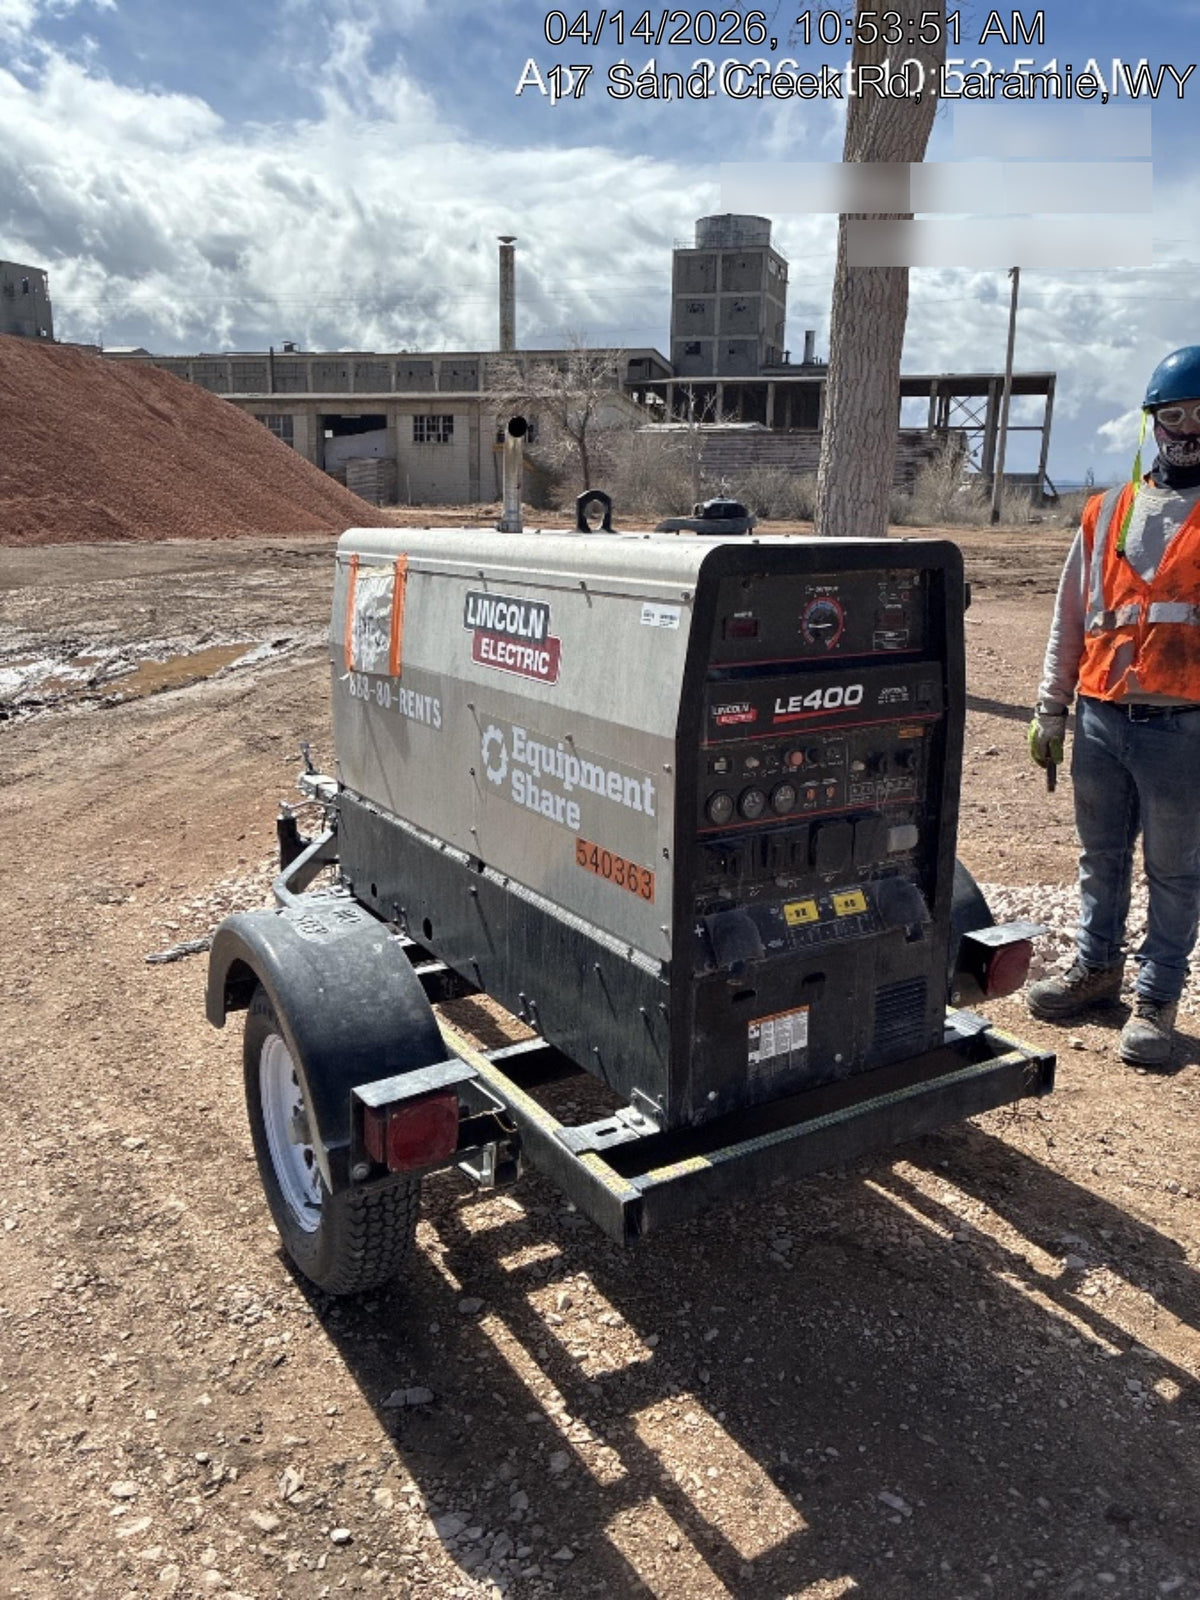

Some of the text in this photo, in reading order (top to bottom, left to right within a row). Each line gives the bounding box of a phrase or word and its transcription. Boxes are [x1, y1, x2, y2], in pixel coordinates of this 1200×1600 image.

[466, 596, 546, 640] LINCOLN
[480, 638, 550, 675] ELECTRIC
[774, 684, 864, 714] LE400
[511, 725, 656, 817] Equipment
[511, 768, 581, 831] Share
[576, 839, 653, 901] 540363
